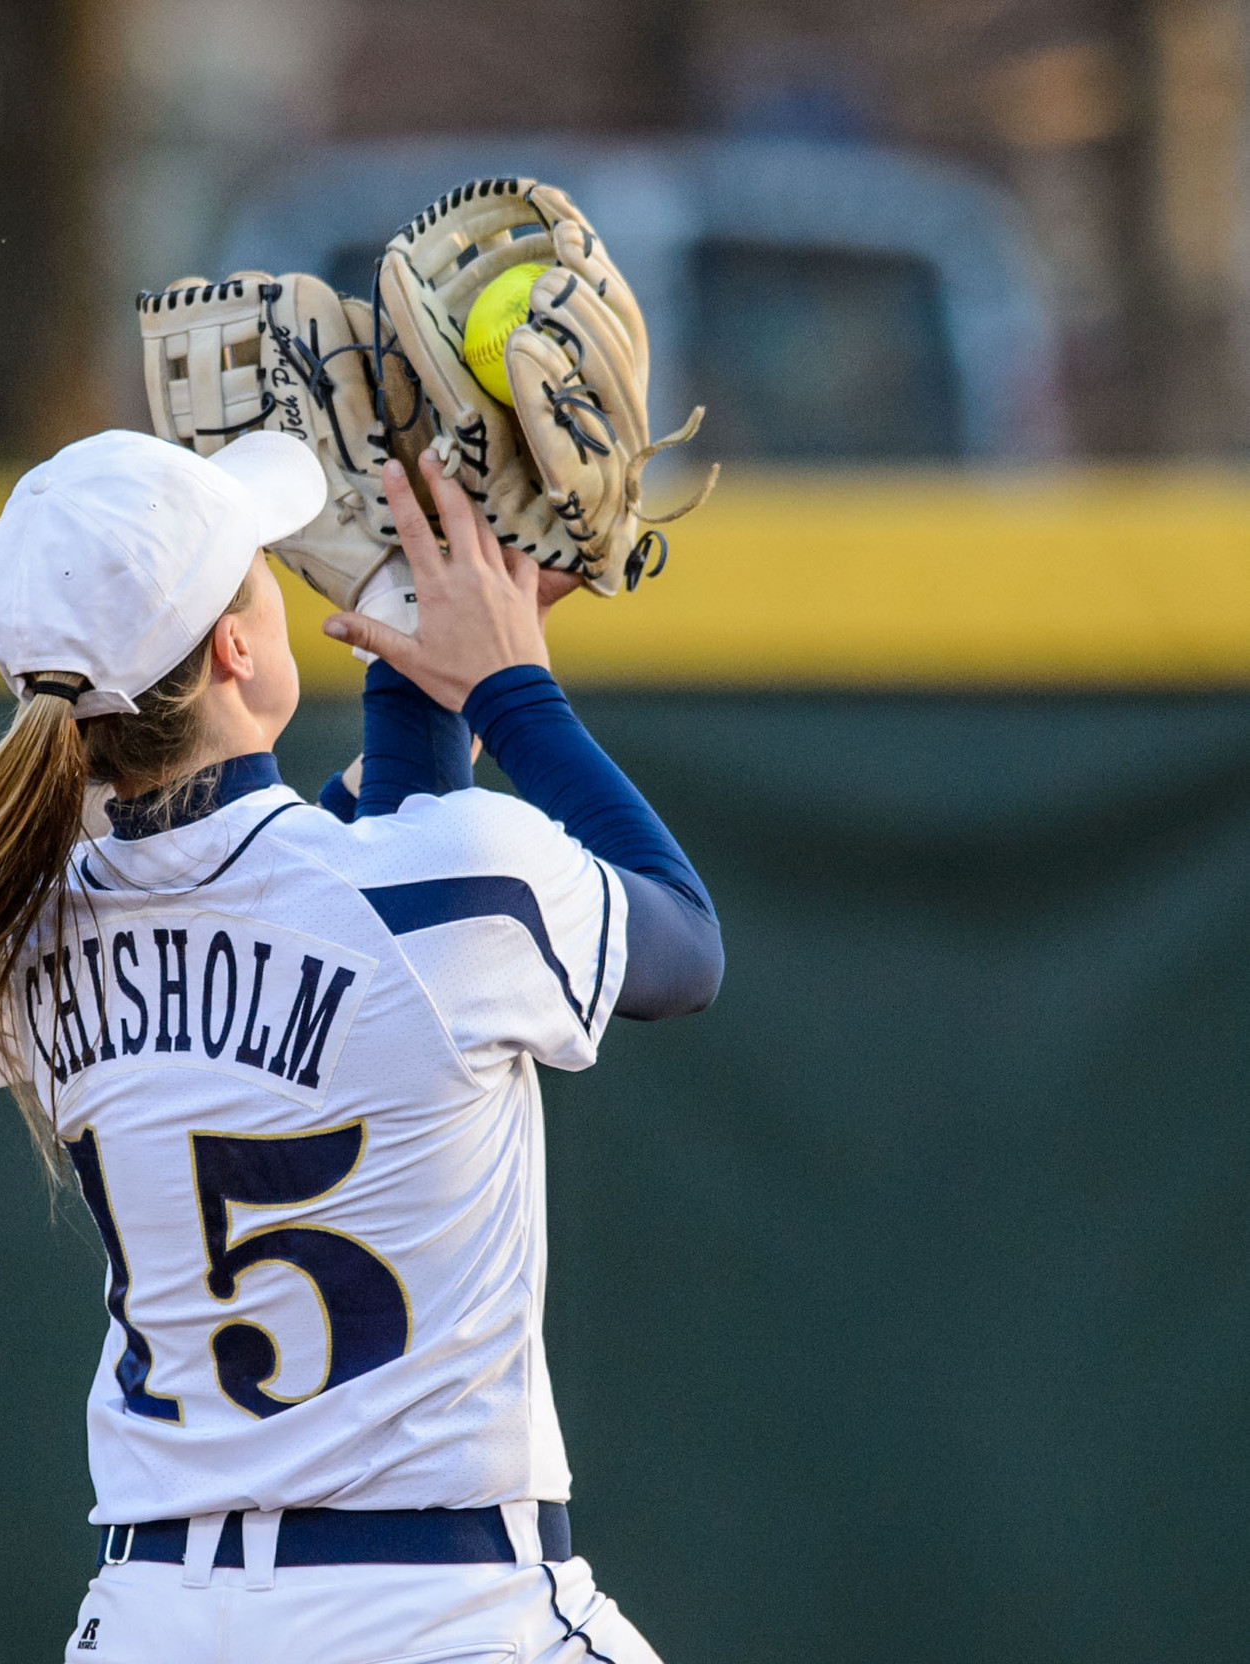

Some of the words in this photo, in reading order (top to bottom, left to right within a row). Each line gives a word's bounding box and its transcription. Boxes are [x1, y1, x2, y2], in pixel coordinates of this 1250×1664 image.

[25, 929, 356, 1089] CHISHOLM
[58, 1119, 413, 1426] 15
[81, 1618, 100, 1640] R
